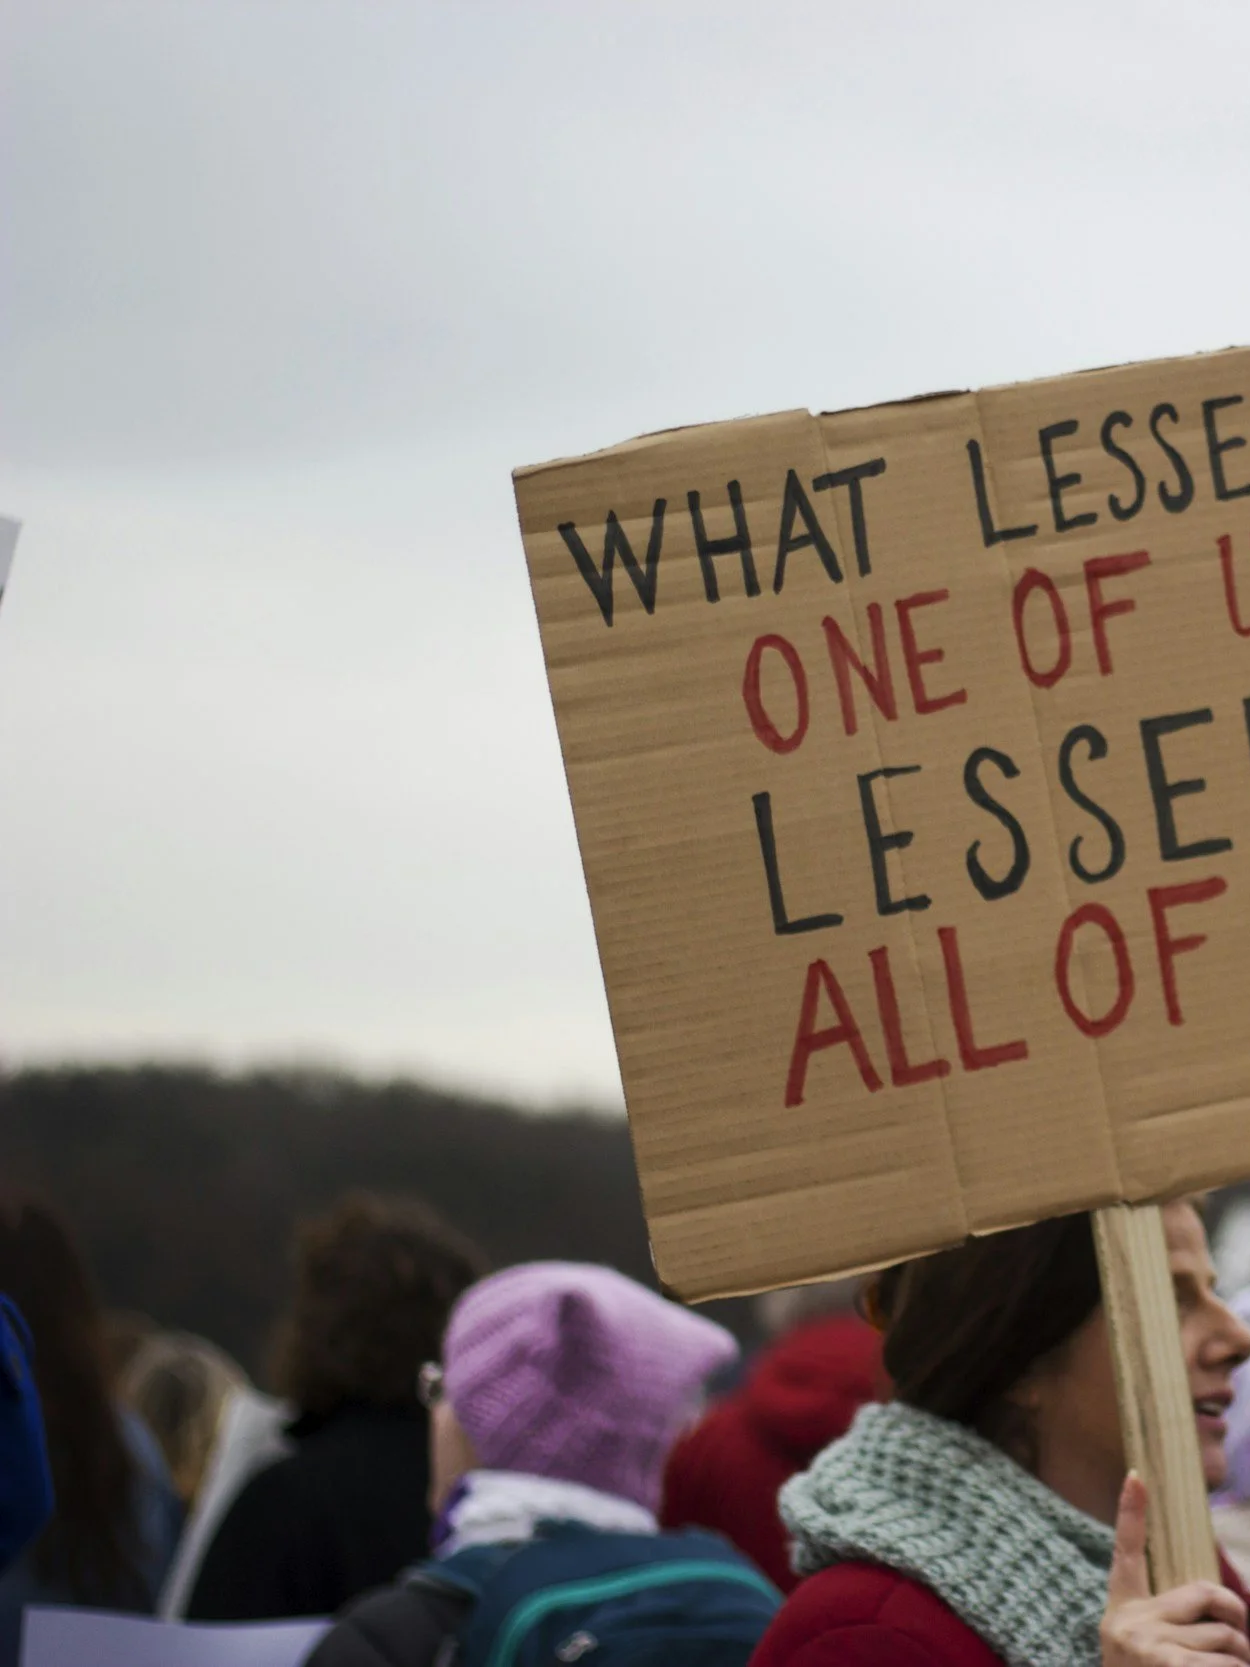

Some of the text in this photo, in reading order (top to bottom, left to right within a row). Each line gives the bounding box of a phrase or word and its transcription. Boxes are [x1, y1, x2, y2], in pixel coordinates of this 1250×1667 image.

[558, 458, 886, 627] WHAT
[743, 588, 968, 753] ONE
[1012, 550, 1150, 690] OF
[784, 926, 1028, 1109] ALL
[1055, 876, 1228, 1039] OF
